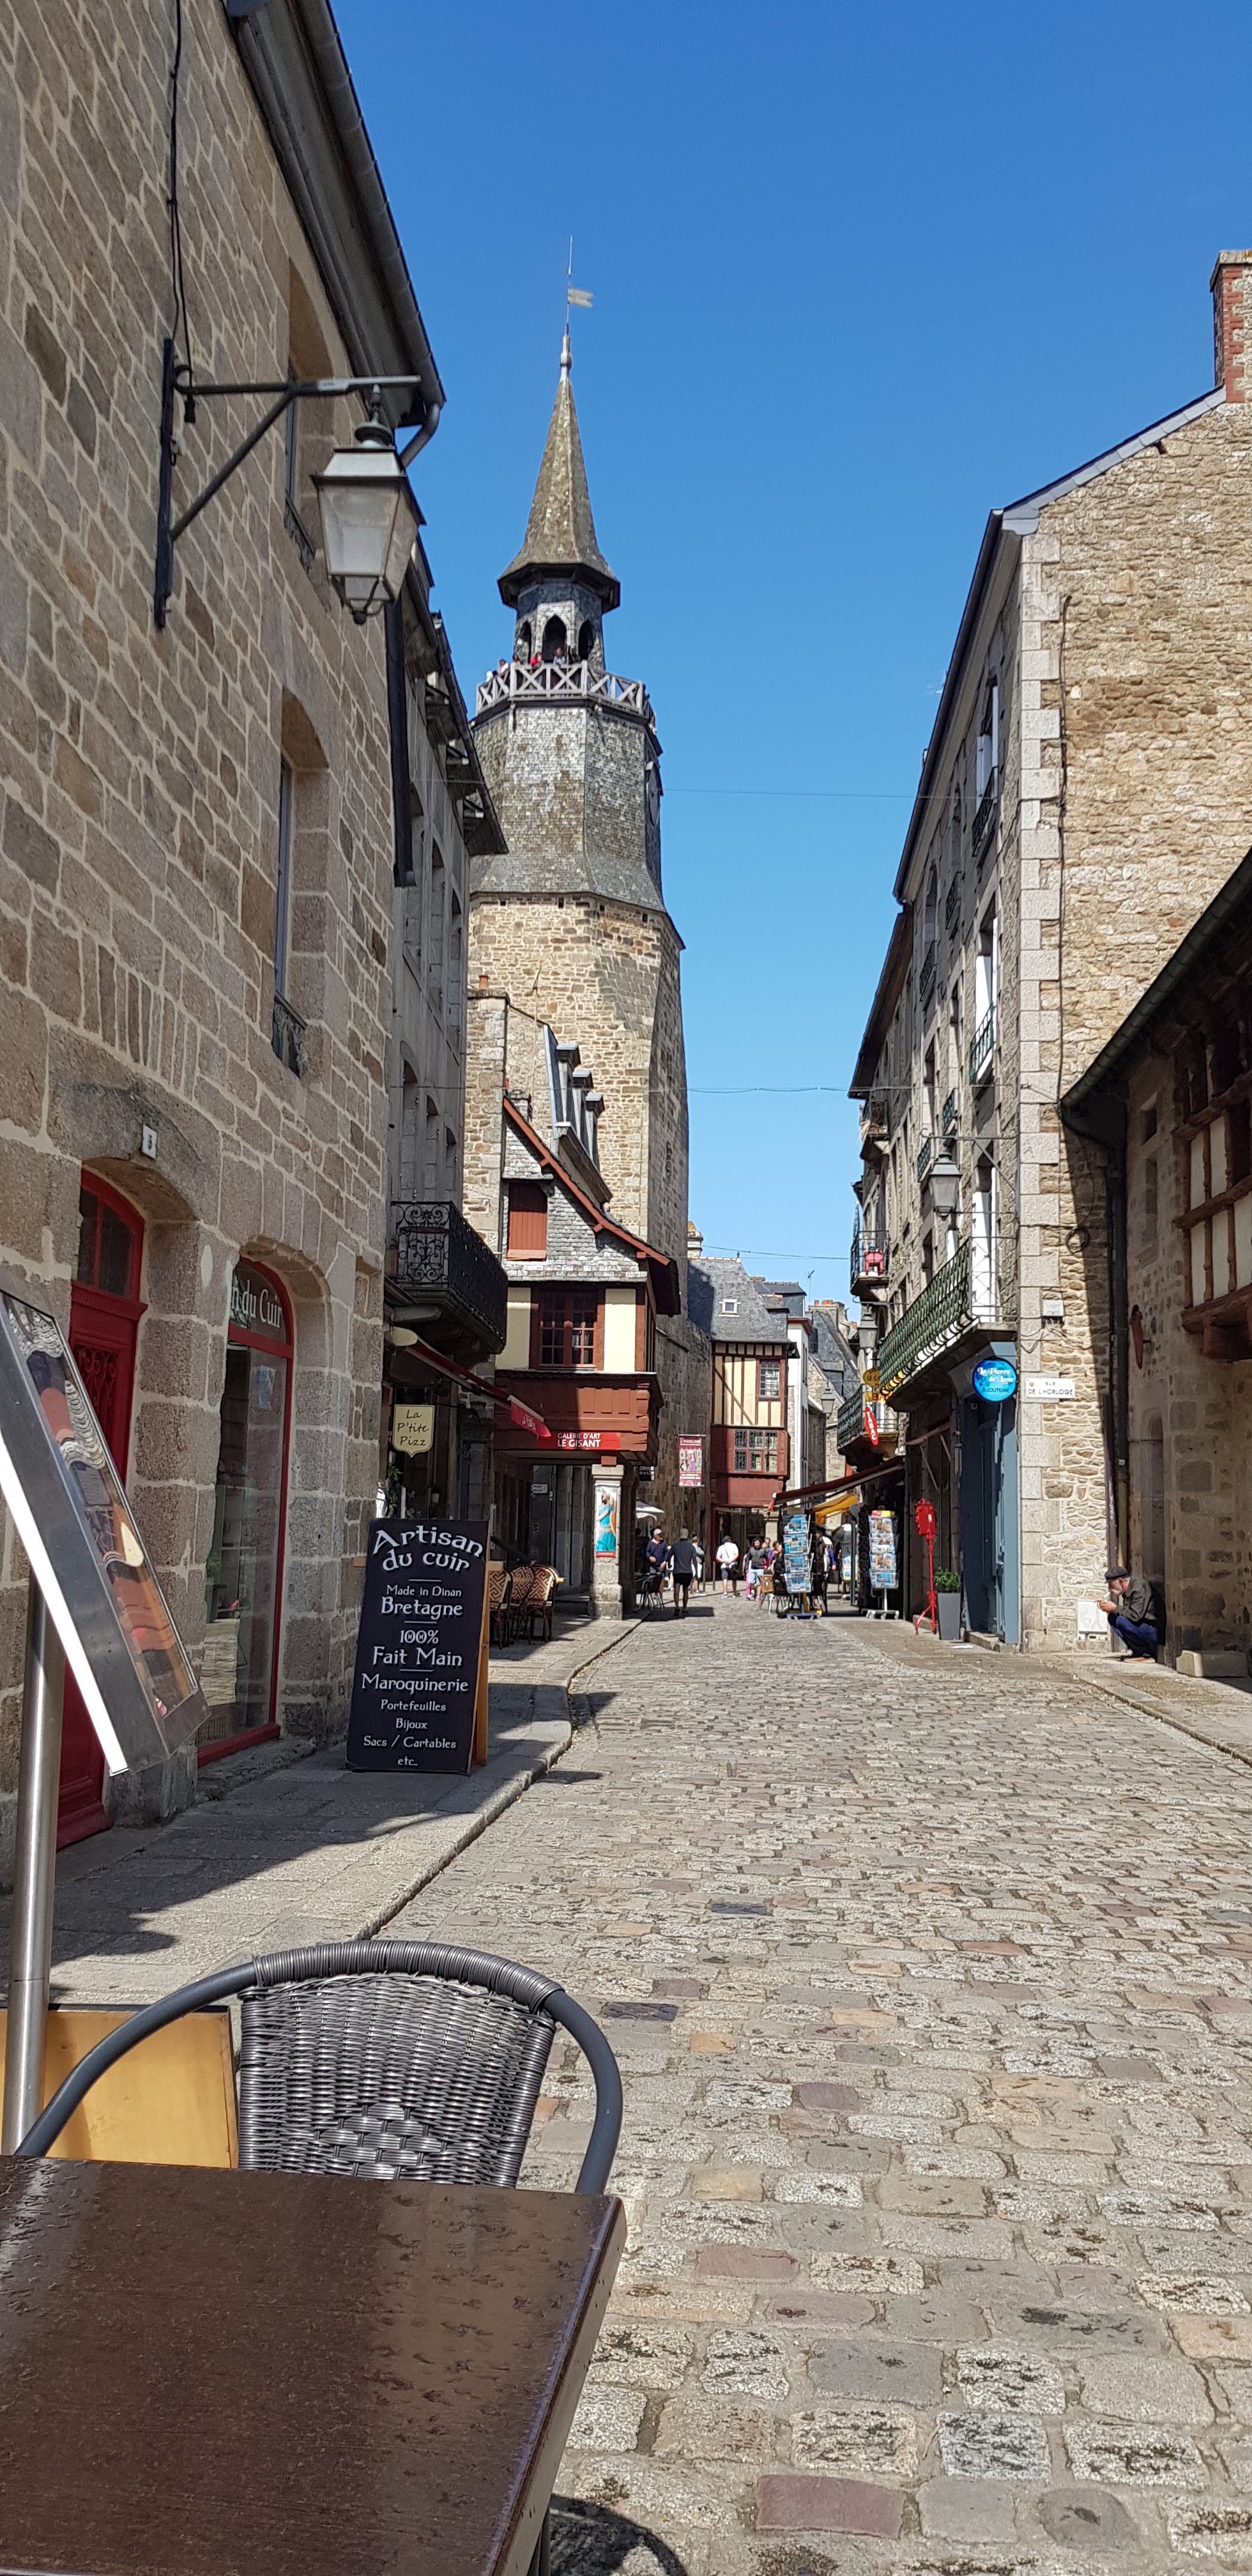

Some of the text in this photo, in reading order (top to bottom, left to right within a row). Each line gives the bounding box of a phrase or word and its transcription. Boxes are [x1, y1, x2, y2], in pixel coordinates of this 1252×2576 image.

[243, 1279, 256, 1318] du
[260, 1289, 282, 1328] Cuir
[406, 1409, 422, 1419] La
[397, 1422, 429, 1433] P'tite
[866, 1411, 877, 1441] TABAC
[400, 1436, 426, 1446] Pizz
[557, 1439, 601, 1448] LE GISANT
[373, 1525, 483, 1557] Artisan
[383, 1549, 470, 1572] du cuir
[386, 1584, 462, 1597] Made in Dinan
[381, 1596, 463, 1620] Bretagne
[400, 1629, 439, 1644] 100%
[373, 1646, 462, 1666] Fait Main
[362, 1673, 469, 1695] Maroquinerie
[381, 1699, 447, 1711] Portefeuilles
[395, 1717, 428, 1731] Bijoux
[363, 1735, 457, 1749] Sacs / Cartables
